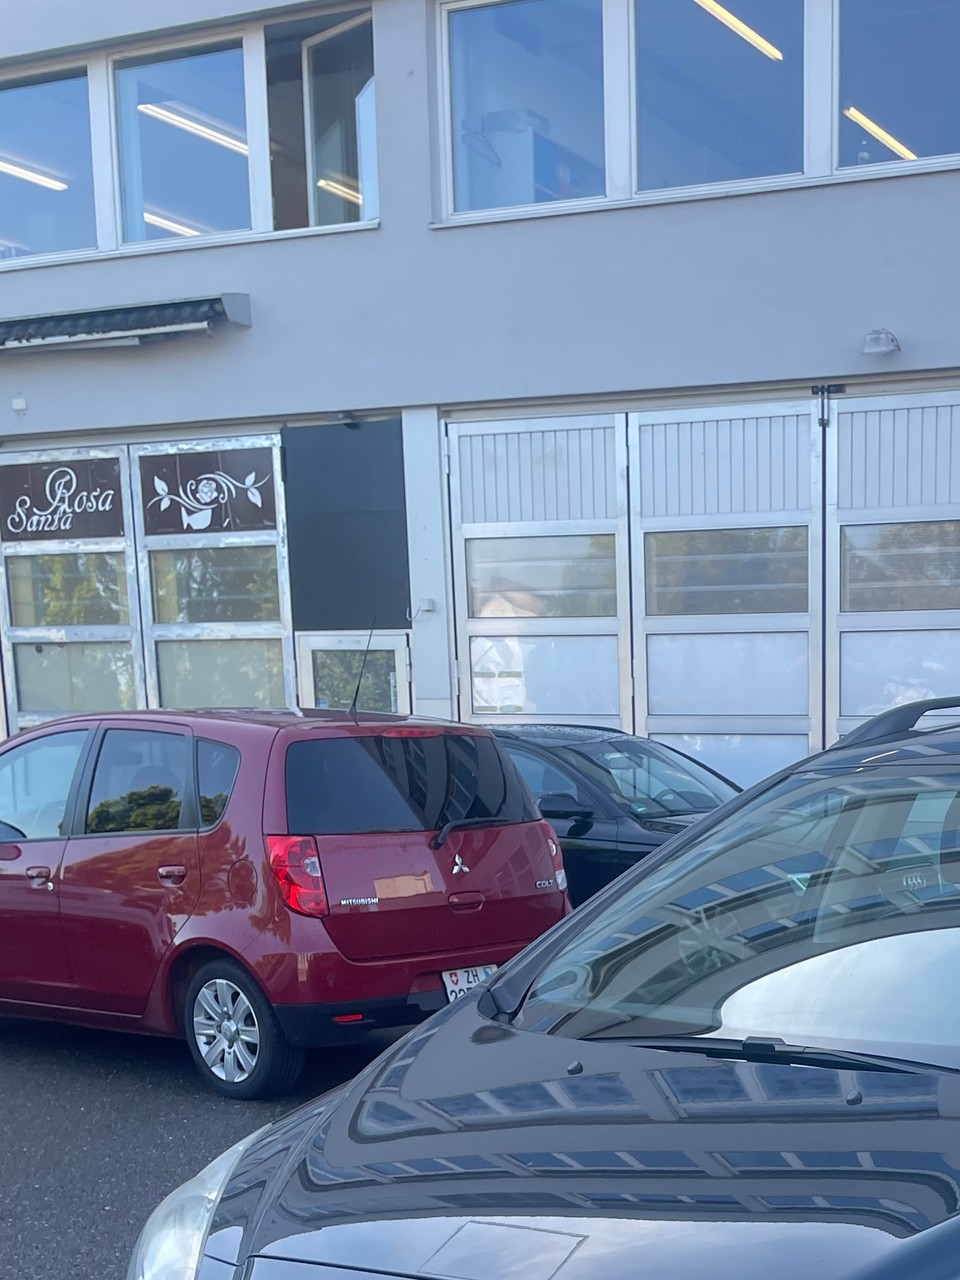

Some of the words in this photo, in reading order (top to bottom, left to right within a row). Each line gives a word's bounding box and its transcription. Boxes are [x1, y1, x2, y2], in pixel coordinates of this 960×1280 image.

[33, 466, 115, 515] Rosa
[7, 495, 74, 533] Santa
[535, 879, 554, 889] COLT
[340, 897, 379, 906] MITSUBISHI
[464, 969, 480, 984] ZH
